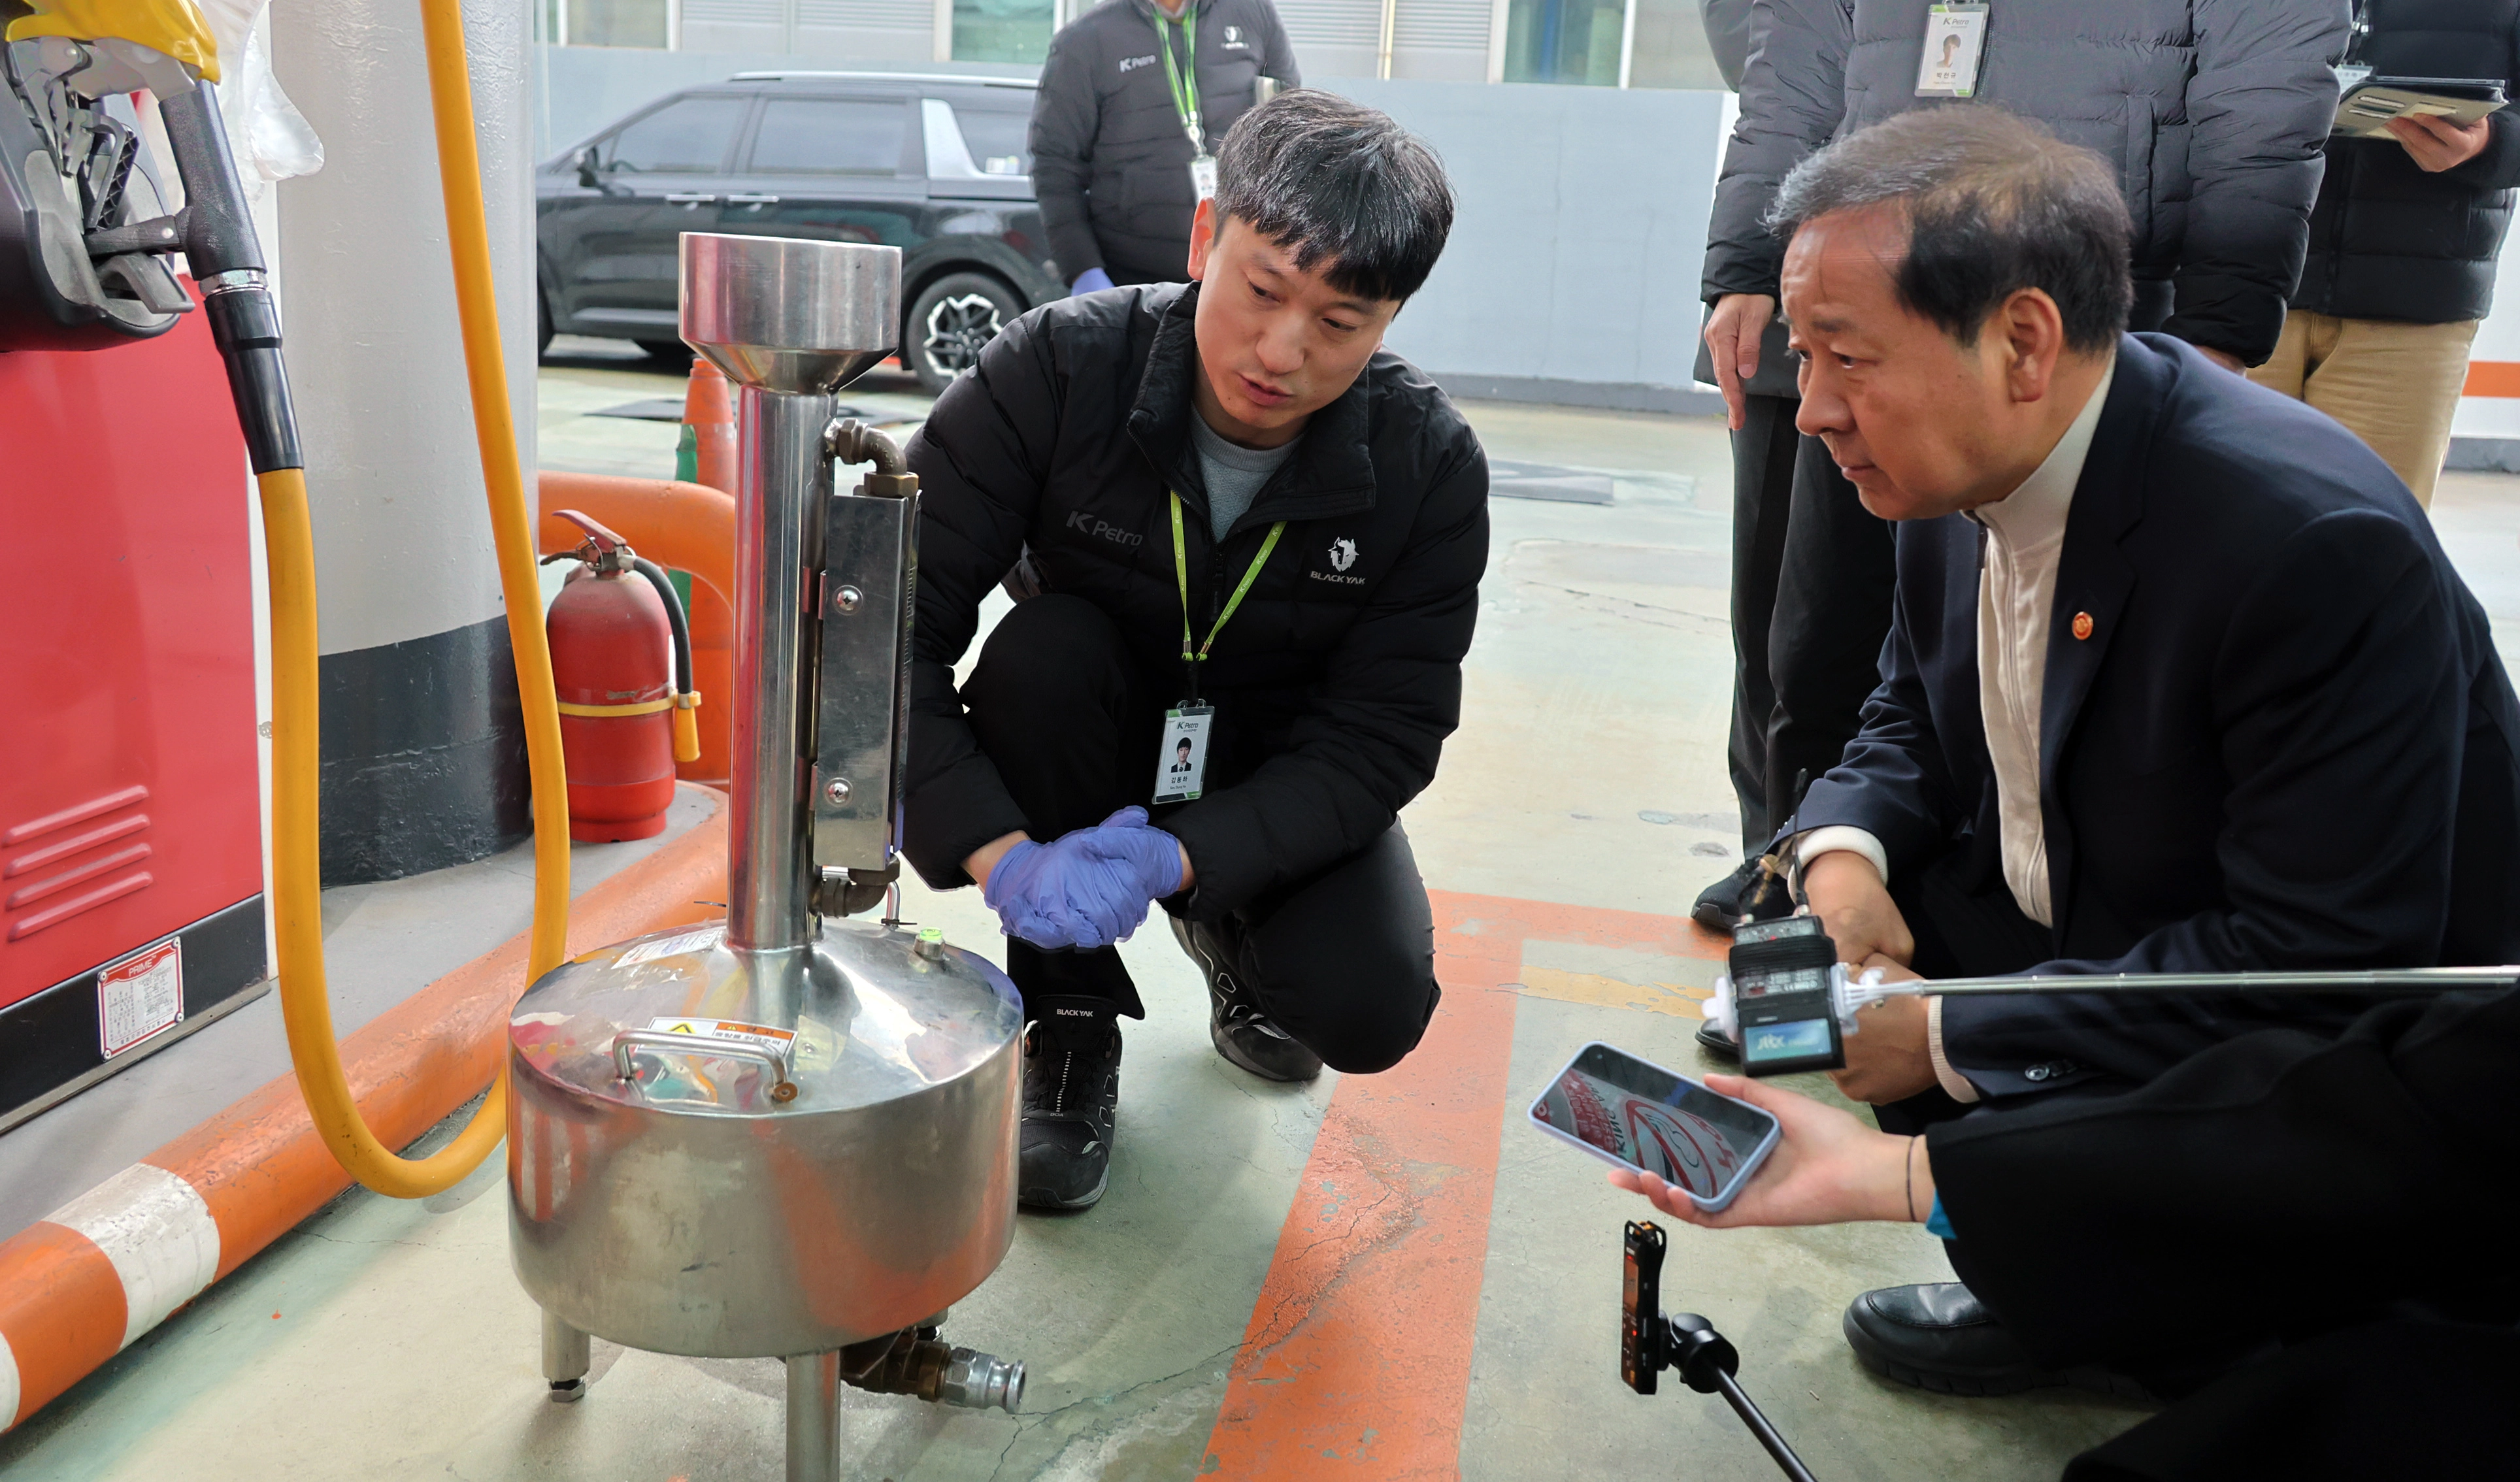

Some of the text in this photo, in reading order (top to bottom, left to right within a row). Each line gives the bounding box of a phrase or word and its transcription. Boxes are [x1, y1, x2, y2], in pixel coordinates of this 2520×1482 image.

[1066, 510, 1143, 546] K Petro
[1310, 570, 1367, 585] BLACK YAK
[129, 959, 153, 978] PRIME
[1057, 1008, 1079, 1017] BLACK
